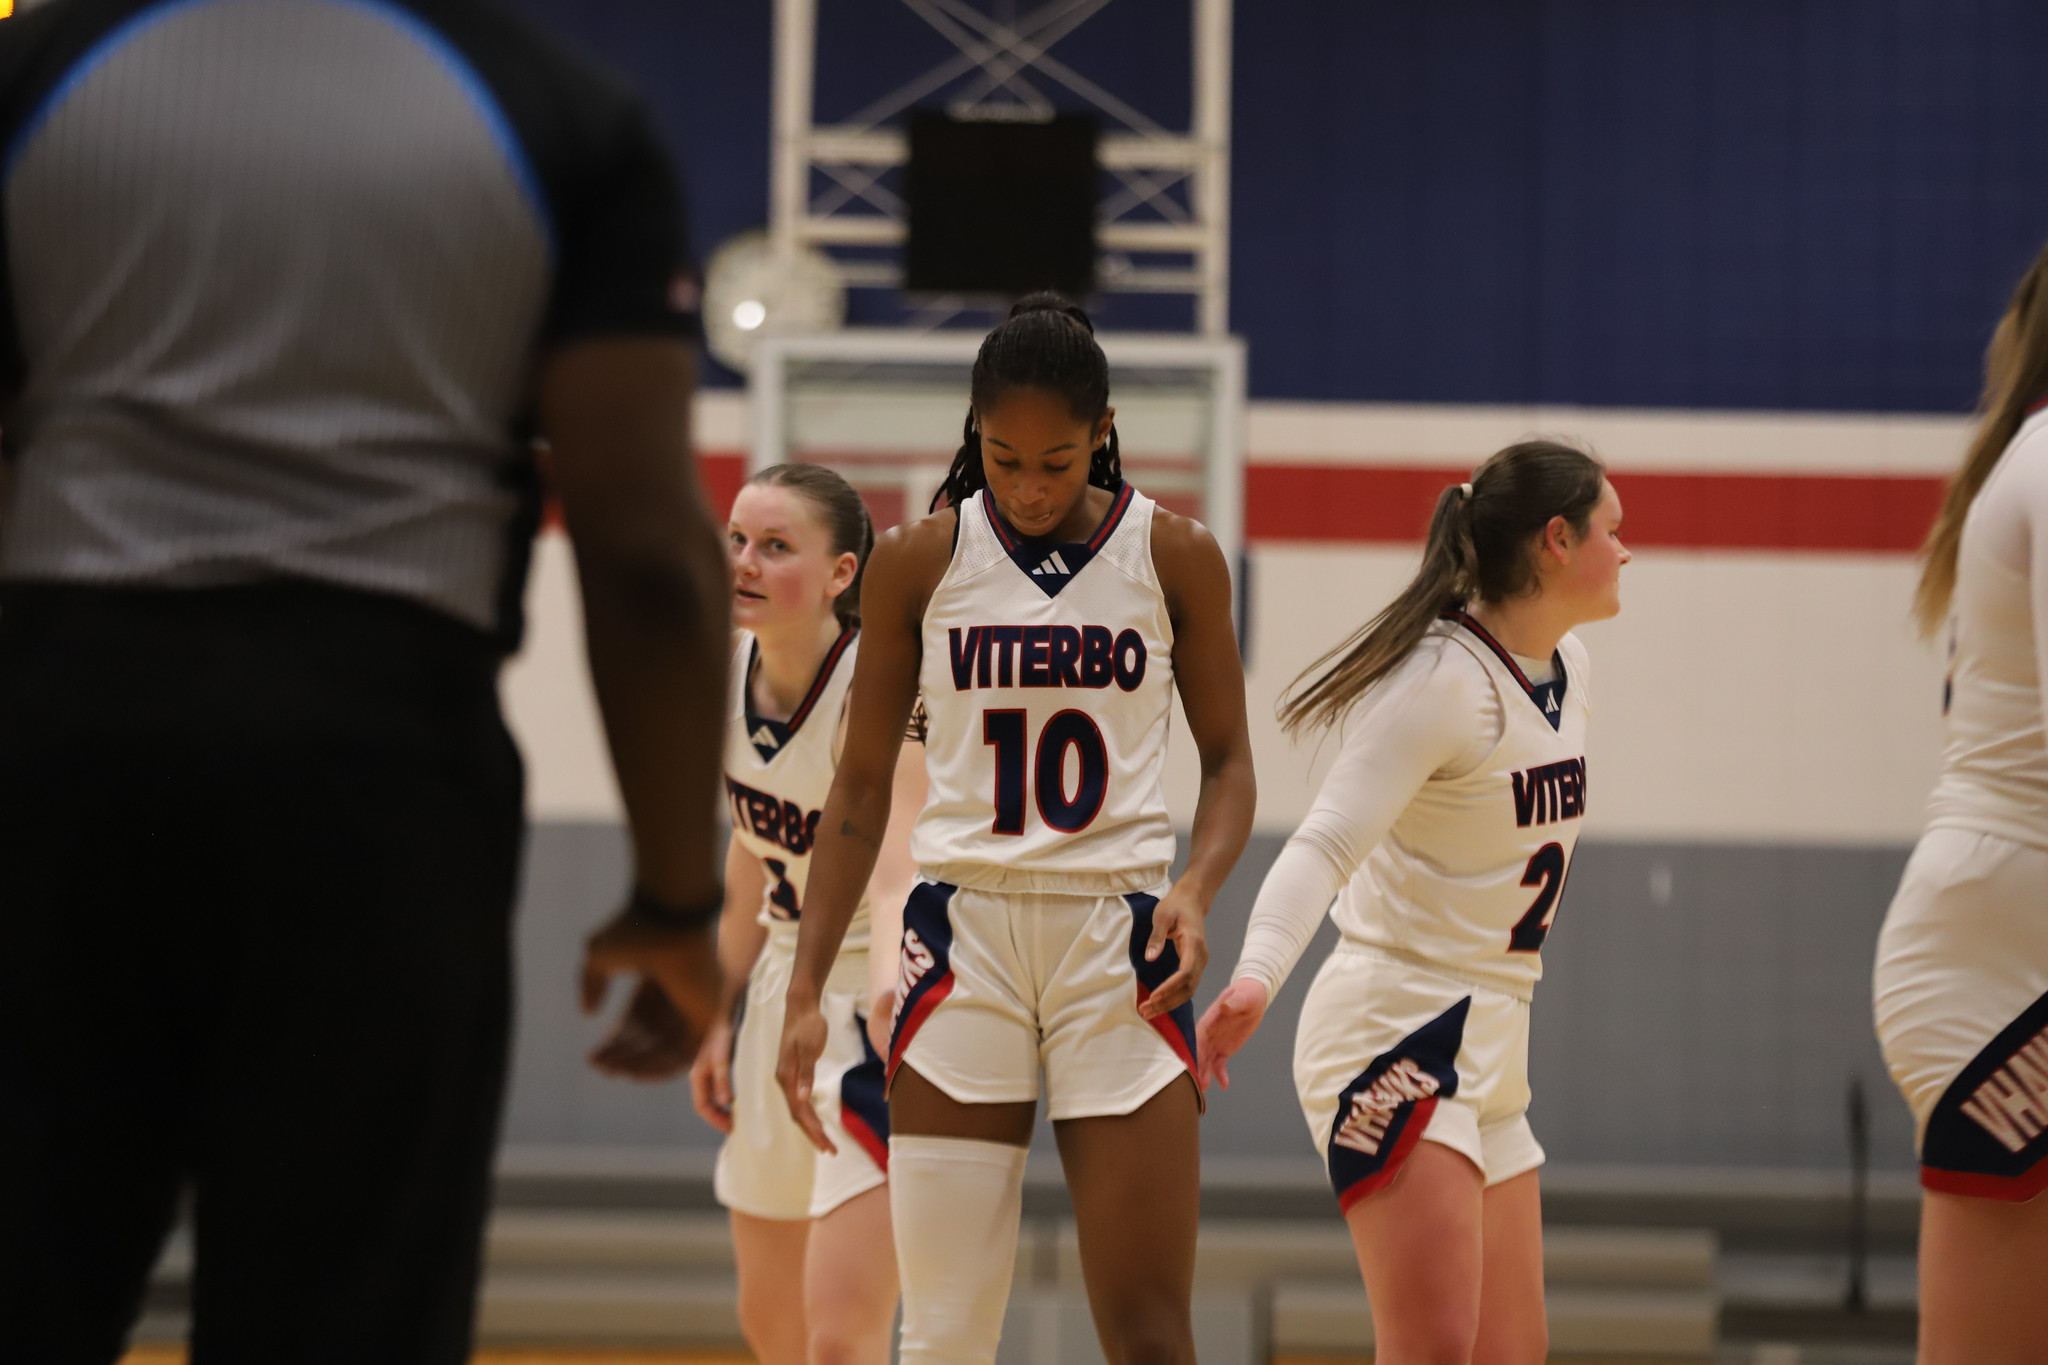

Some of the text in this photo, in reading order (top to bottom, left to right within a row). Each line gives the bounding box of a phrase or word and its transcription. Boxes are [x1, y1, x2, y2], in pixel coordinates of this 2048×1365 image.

[948, 624, 1147, 692] VITERBO
[983, 708, 1109, 836] 10
[1510, 755, 1587, 829] VITER
[1505, 838, 1572, 954] 2
